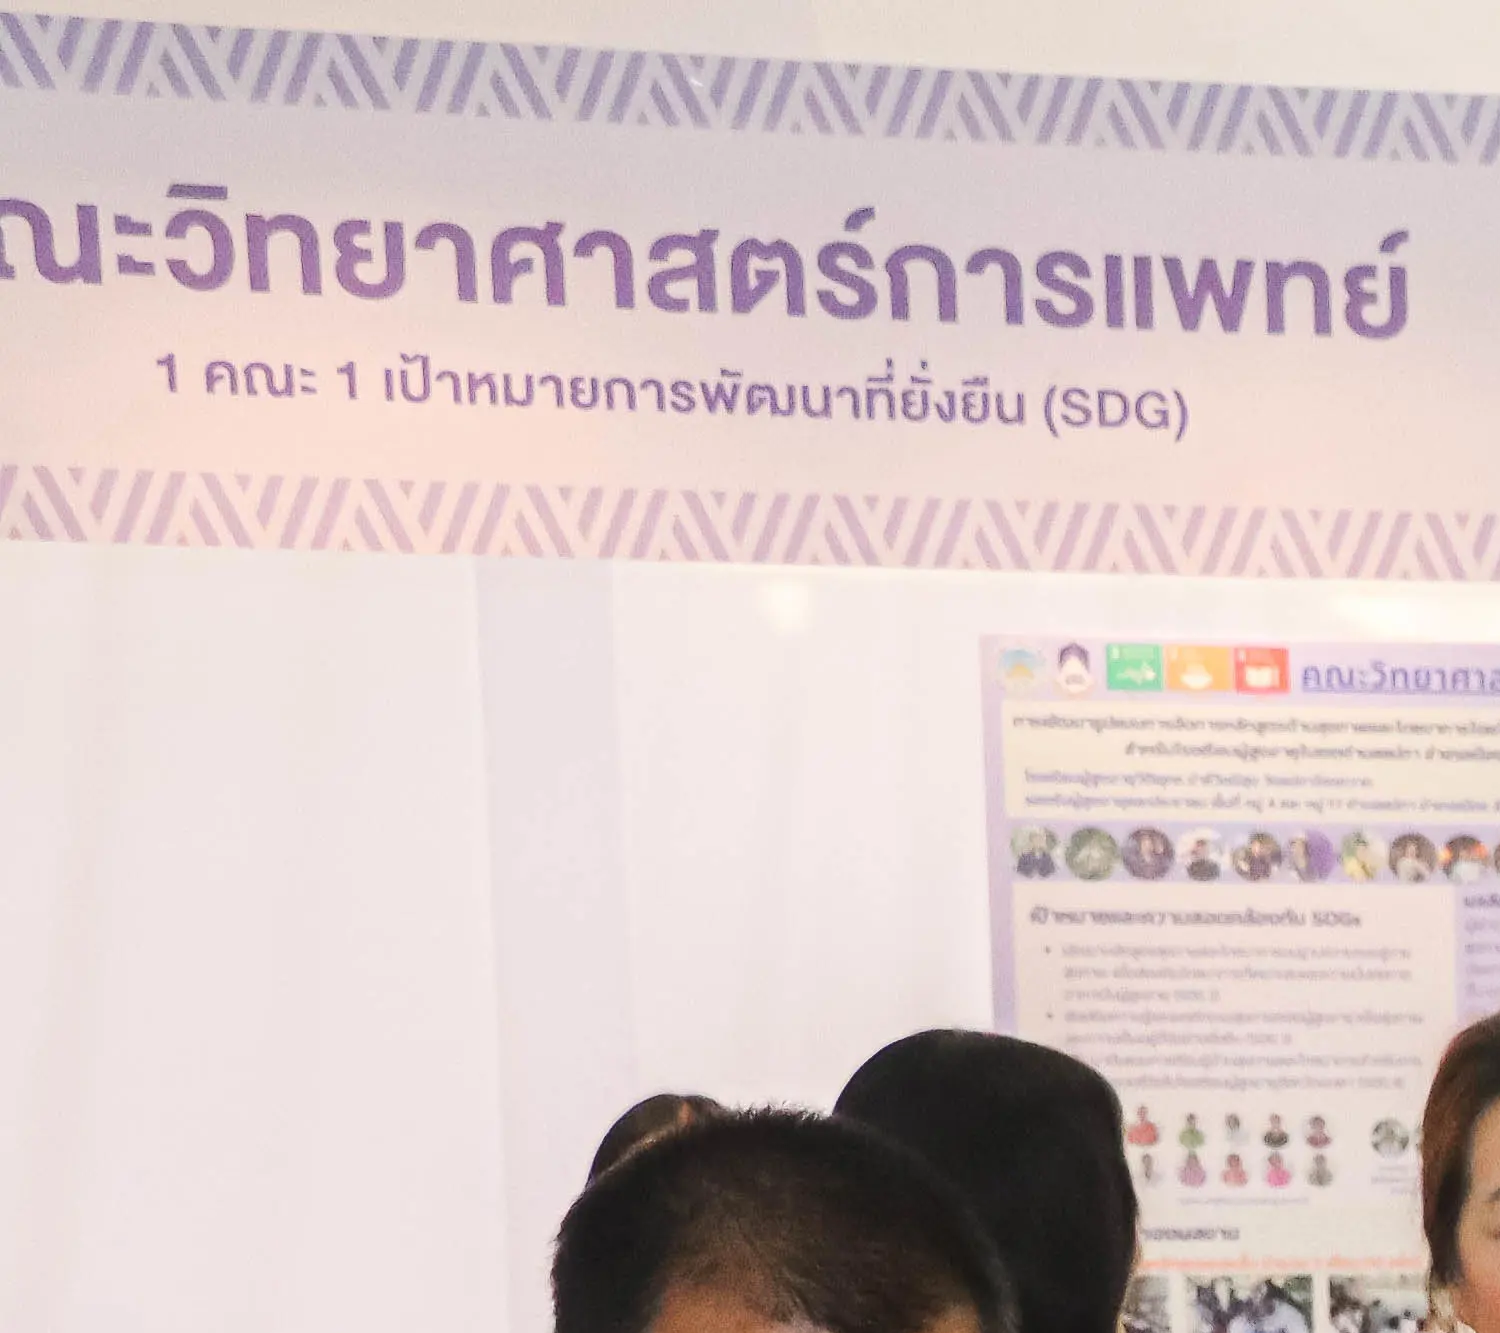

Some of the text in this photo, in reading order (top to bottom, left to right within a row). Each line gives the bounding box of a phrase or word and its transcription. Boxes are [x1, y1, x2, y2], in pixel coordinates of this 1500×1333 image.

[156, 353, 1190, 441] 1 คณะ 1 เป้าหมายการพัฒนาที่ยั่งยืน (SDG)
